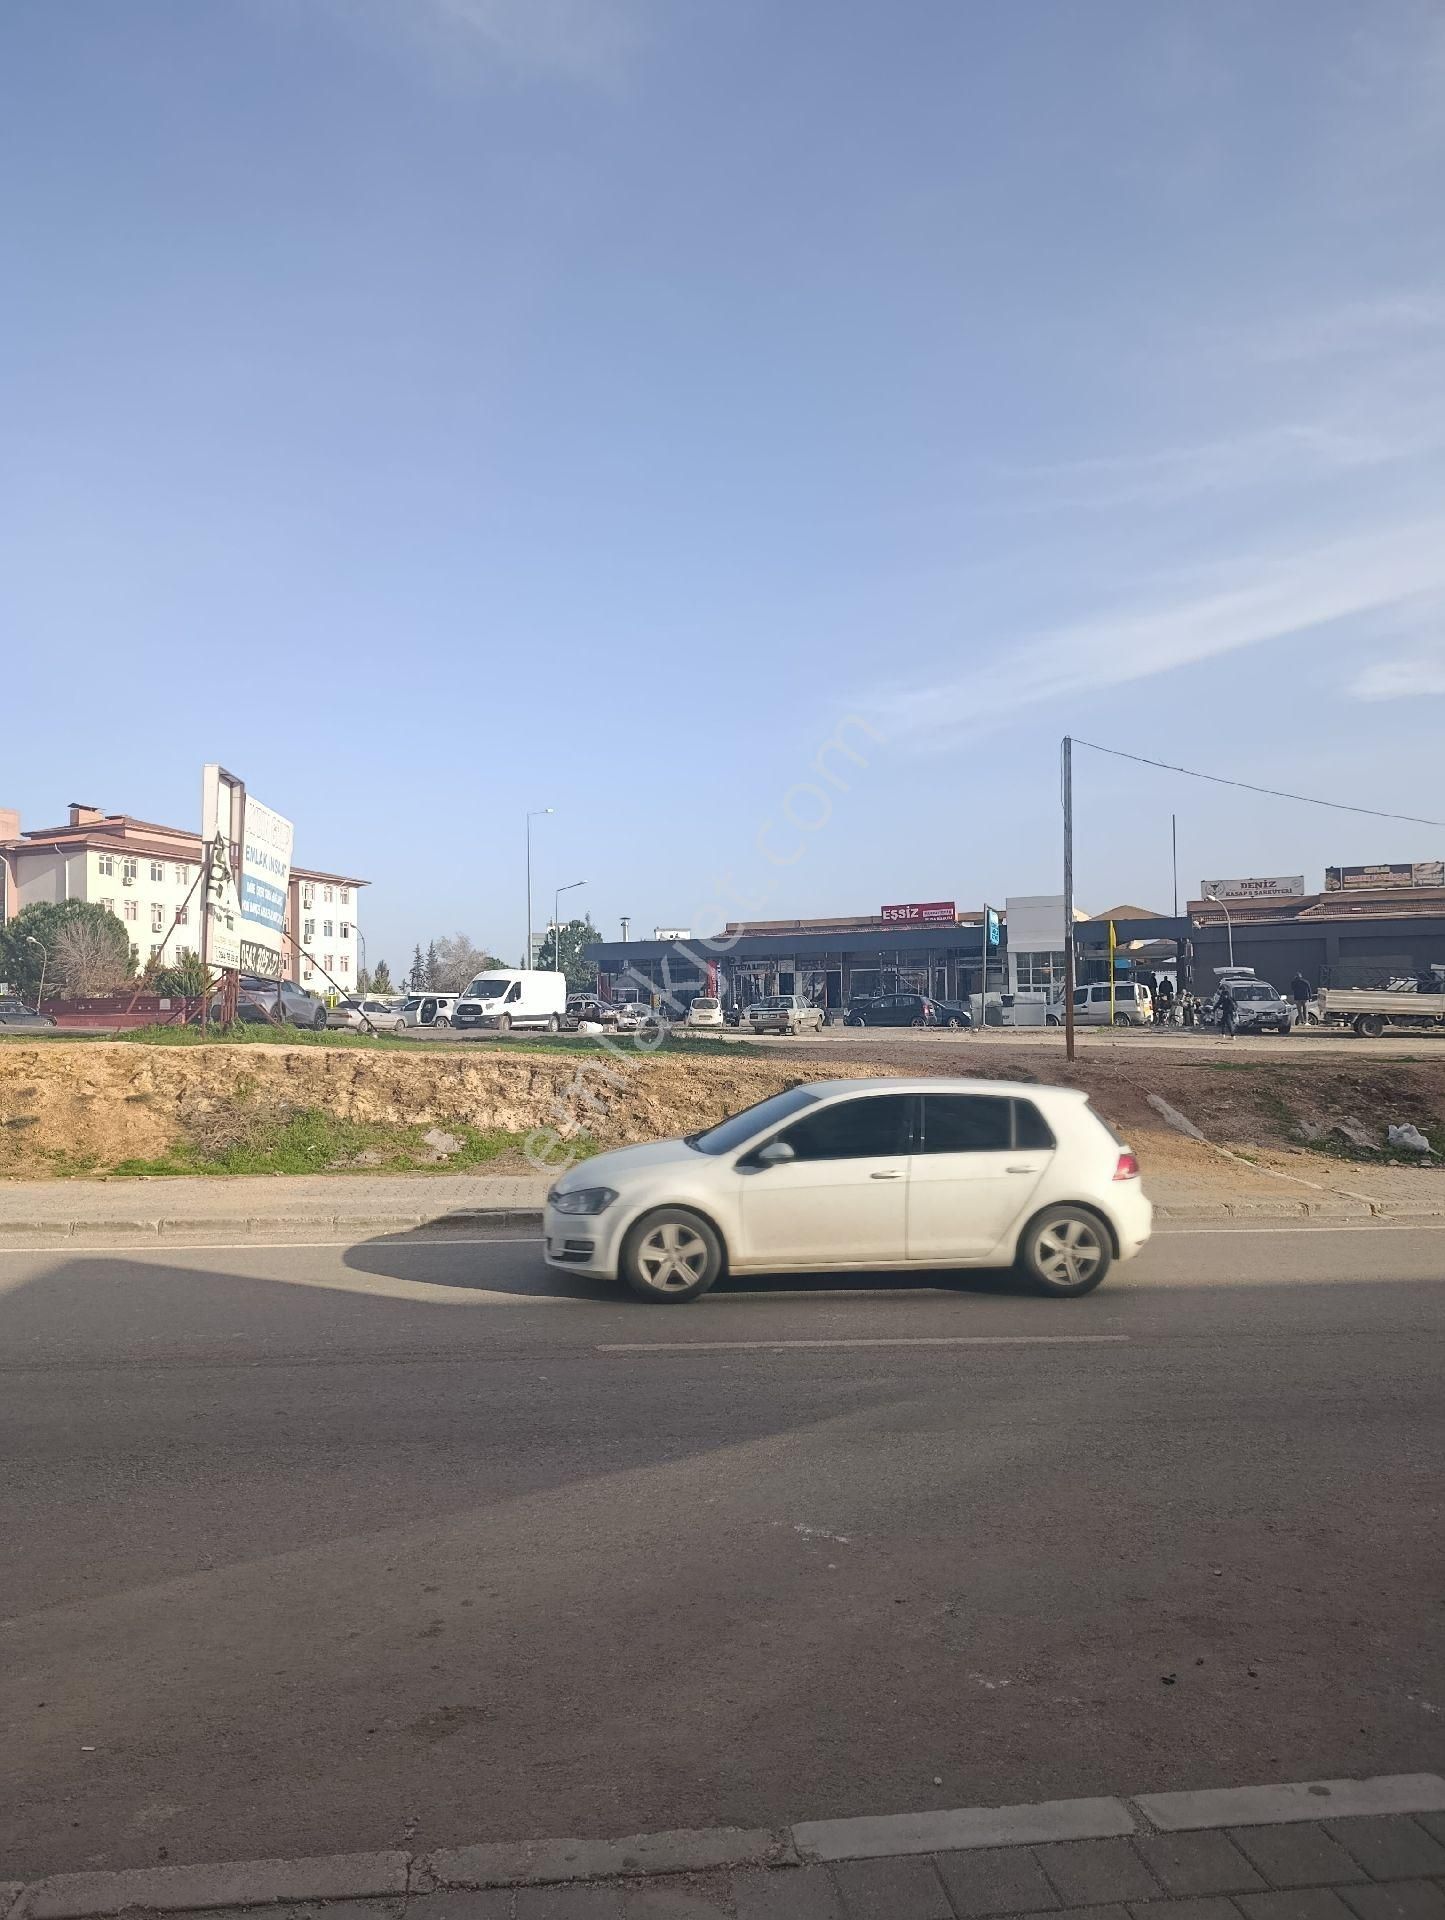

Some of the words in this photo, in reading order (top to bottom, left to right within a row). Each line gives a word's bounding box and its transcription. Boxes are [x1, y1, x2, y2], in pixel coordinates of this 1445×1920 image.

[245, 844, 267, 869] EMLAK
[1239, 879, 1277, 889] DENİZ
[882, 906, 919, 921] EŞSİZ
